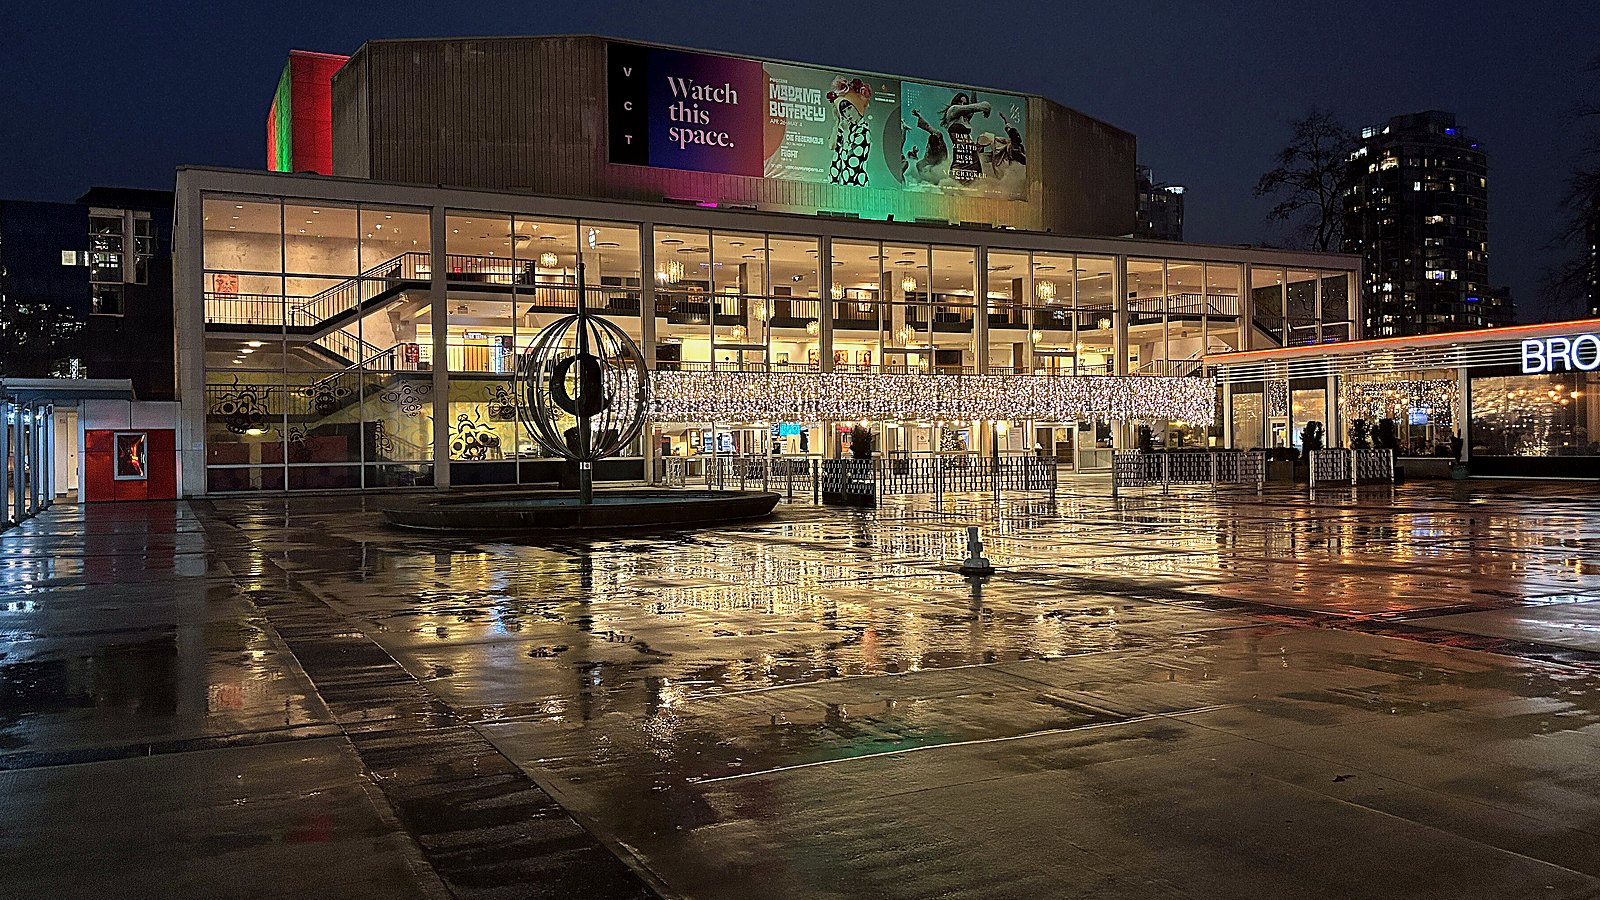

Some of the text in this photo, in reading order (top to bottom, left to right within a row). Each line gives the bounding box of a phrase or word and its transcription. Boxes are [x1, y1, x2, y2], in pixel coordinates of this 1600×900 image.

[667, 76, 739, 105] Watch
[769, 83, 821, 105] MADAMA
[668, 101, 710, 125] this
[769, 100, 826, 122] BUTTERFLY
[668, 126, 735, 150] space.
[952, 143, 978, 151] ZENITH
